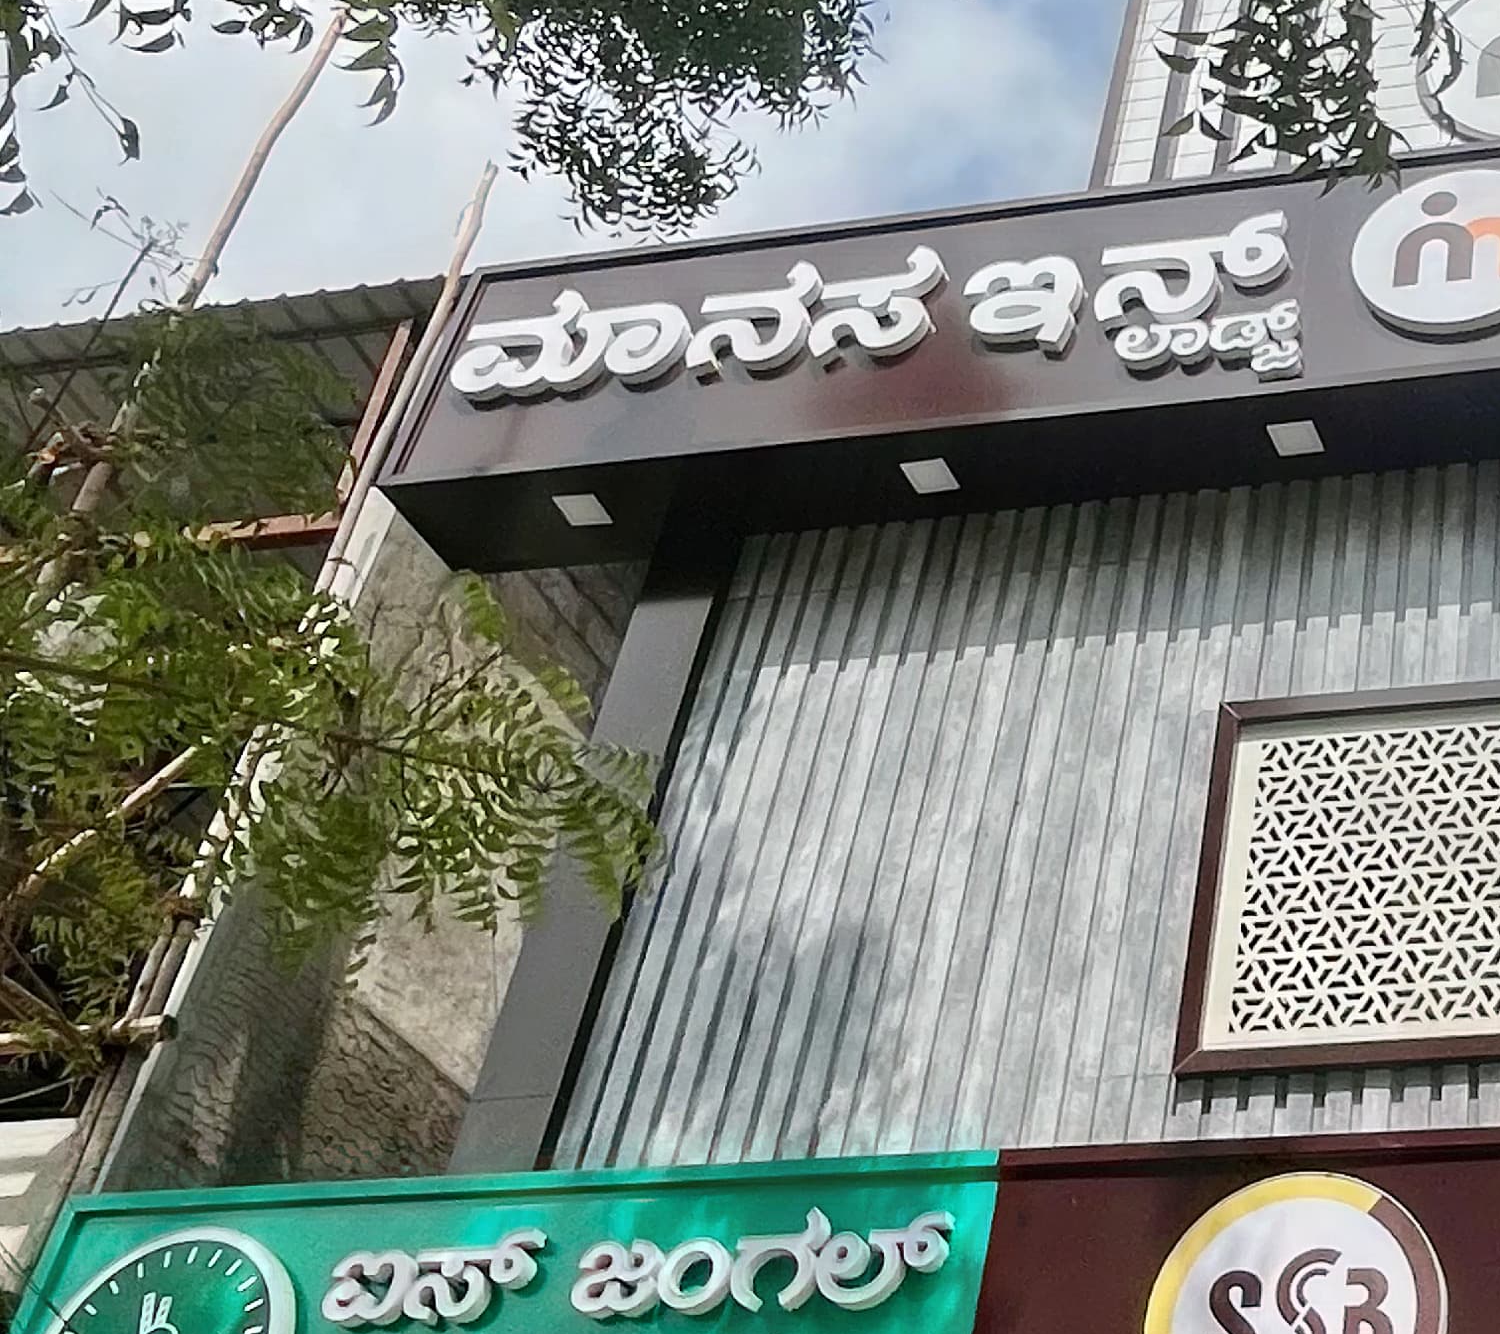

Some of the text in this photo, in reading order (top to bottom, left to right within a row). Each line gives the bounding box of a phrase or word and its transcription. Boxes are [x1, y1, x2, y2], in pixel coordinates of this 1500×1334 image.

[450, 245, 940, 398] ಮಾನಸ
[321, 1207, 956, 1327] ಐಸ್ ಜಂಗಲ್
